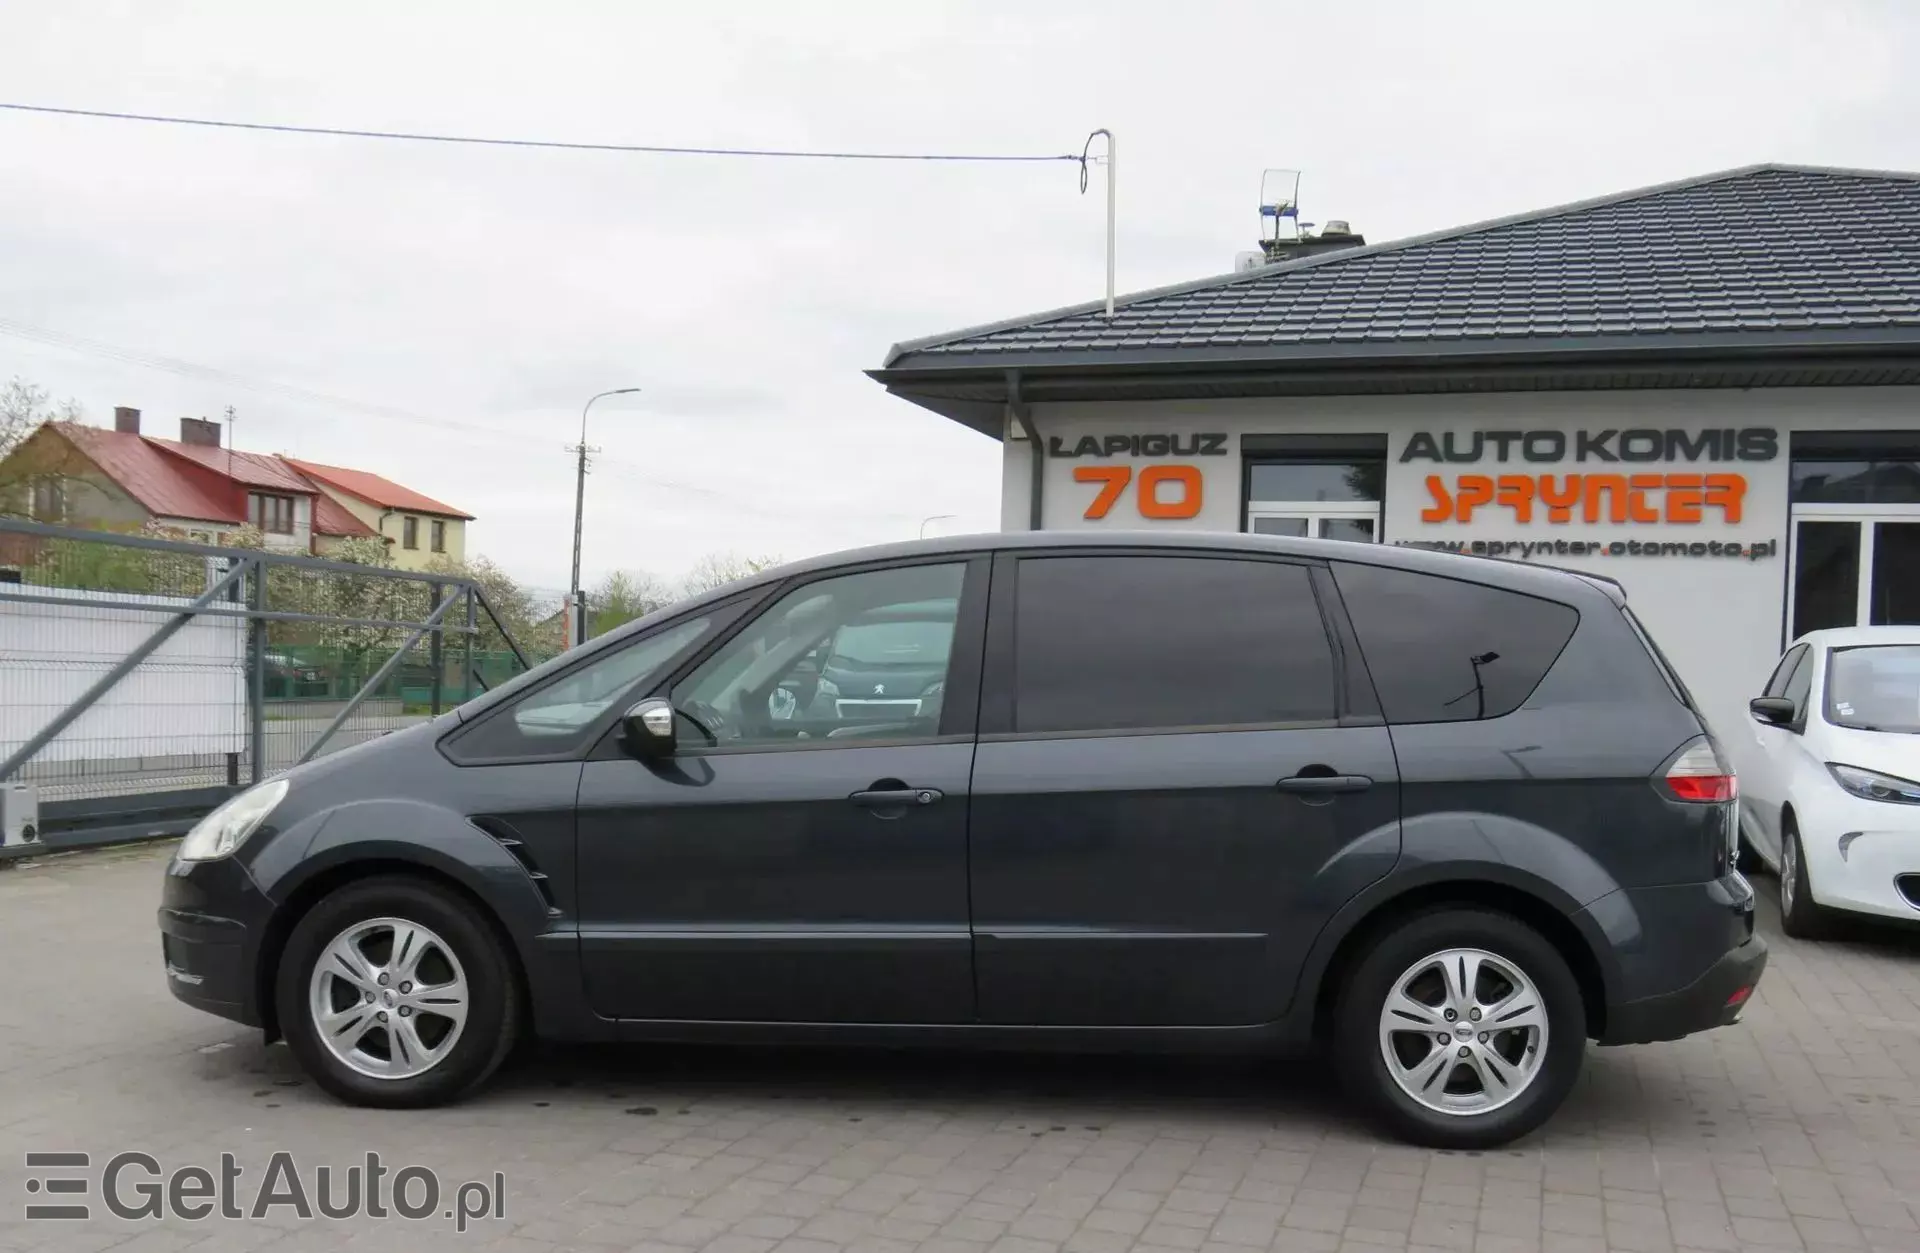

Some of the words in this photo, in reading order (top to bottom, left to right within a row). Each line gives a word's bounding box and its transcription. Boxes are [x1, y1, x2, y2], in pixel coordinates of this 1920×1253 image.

[1400, 429, 1566, 463] AUTO
[1576, 427, 1778, 463] KOMIS
[1073, 465, 1203, 519] 70
[1421, 473, 1747, 524] SPRYNTER
[1395, 539, 1777, 561] w.sprynter.otomoto.pl
